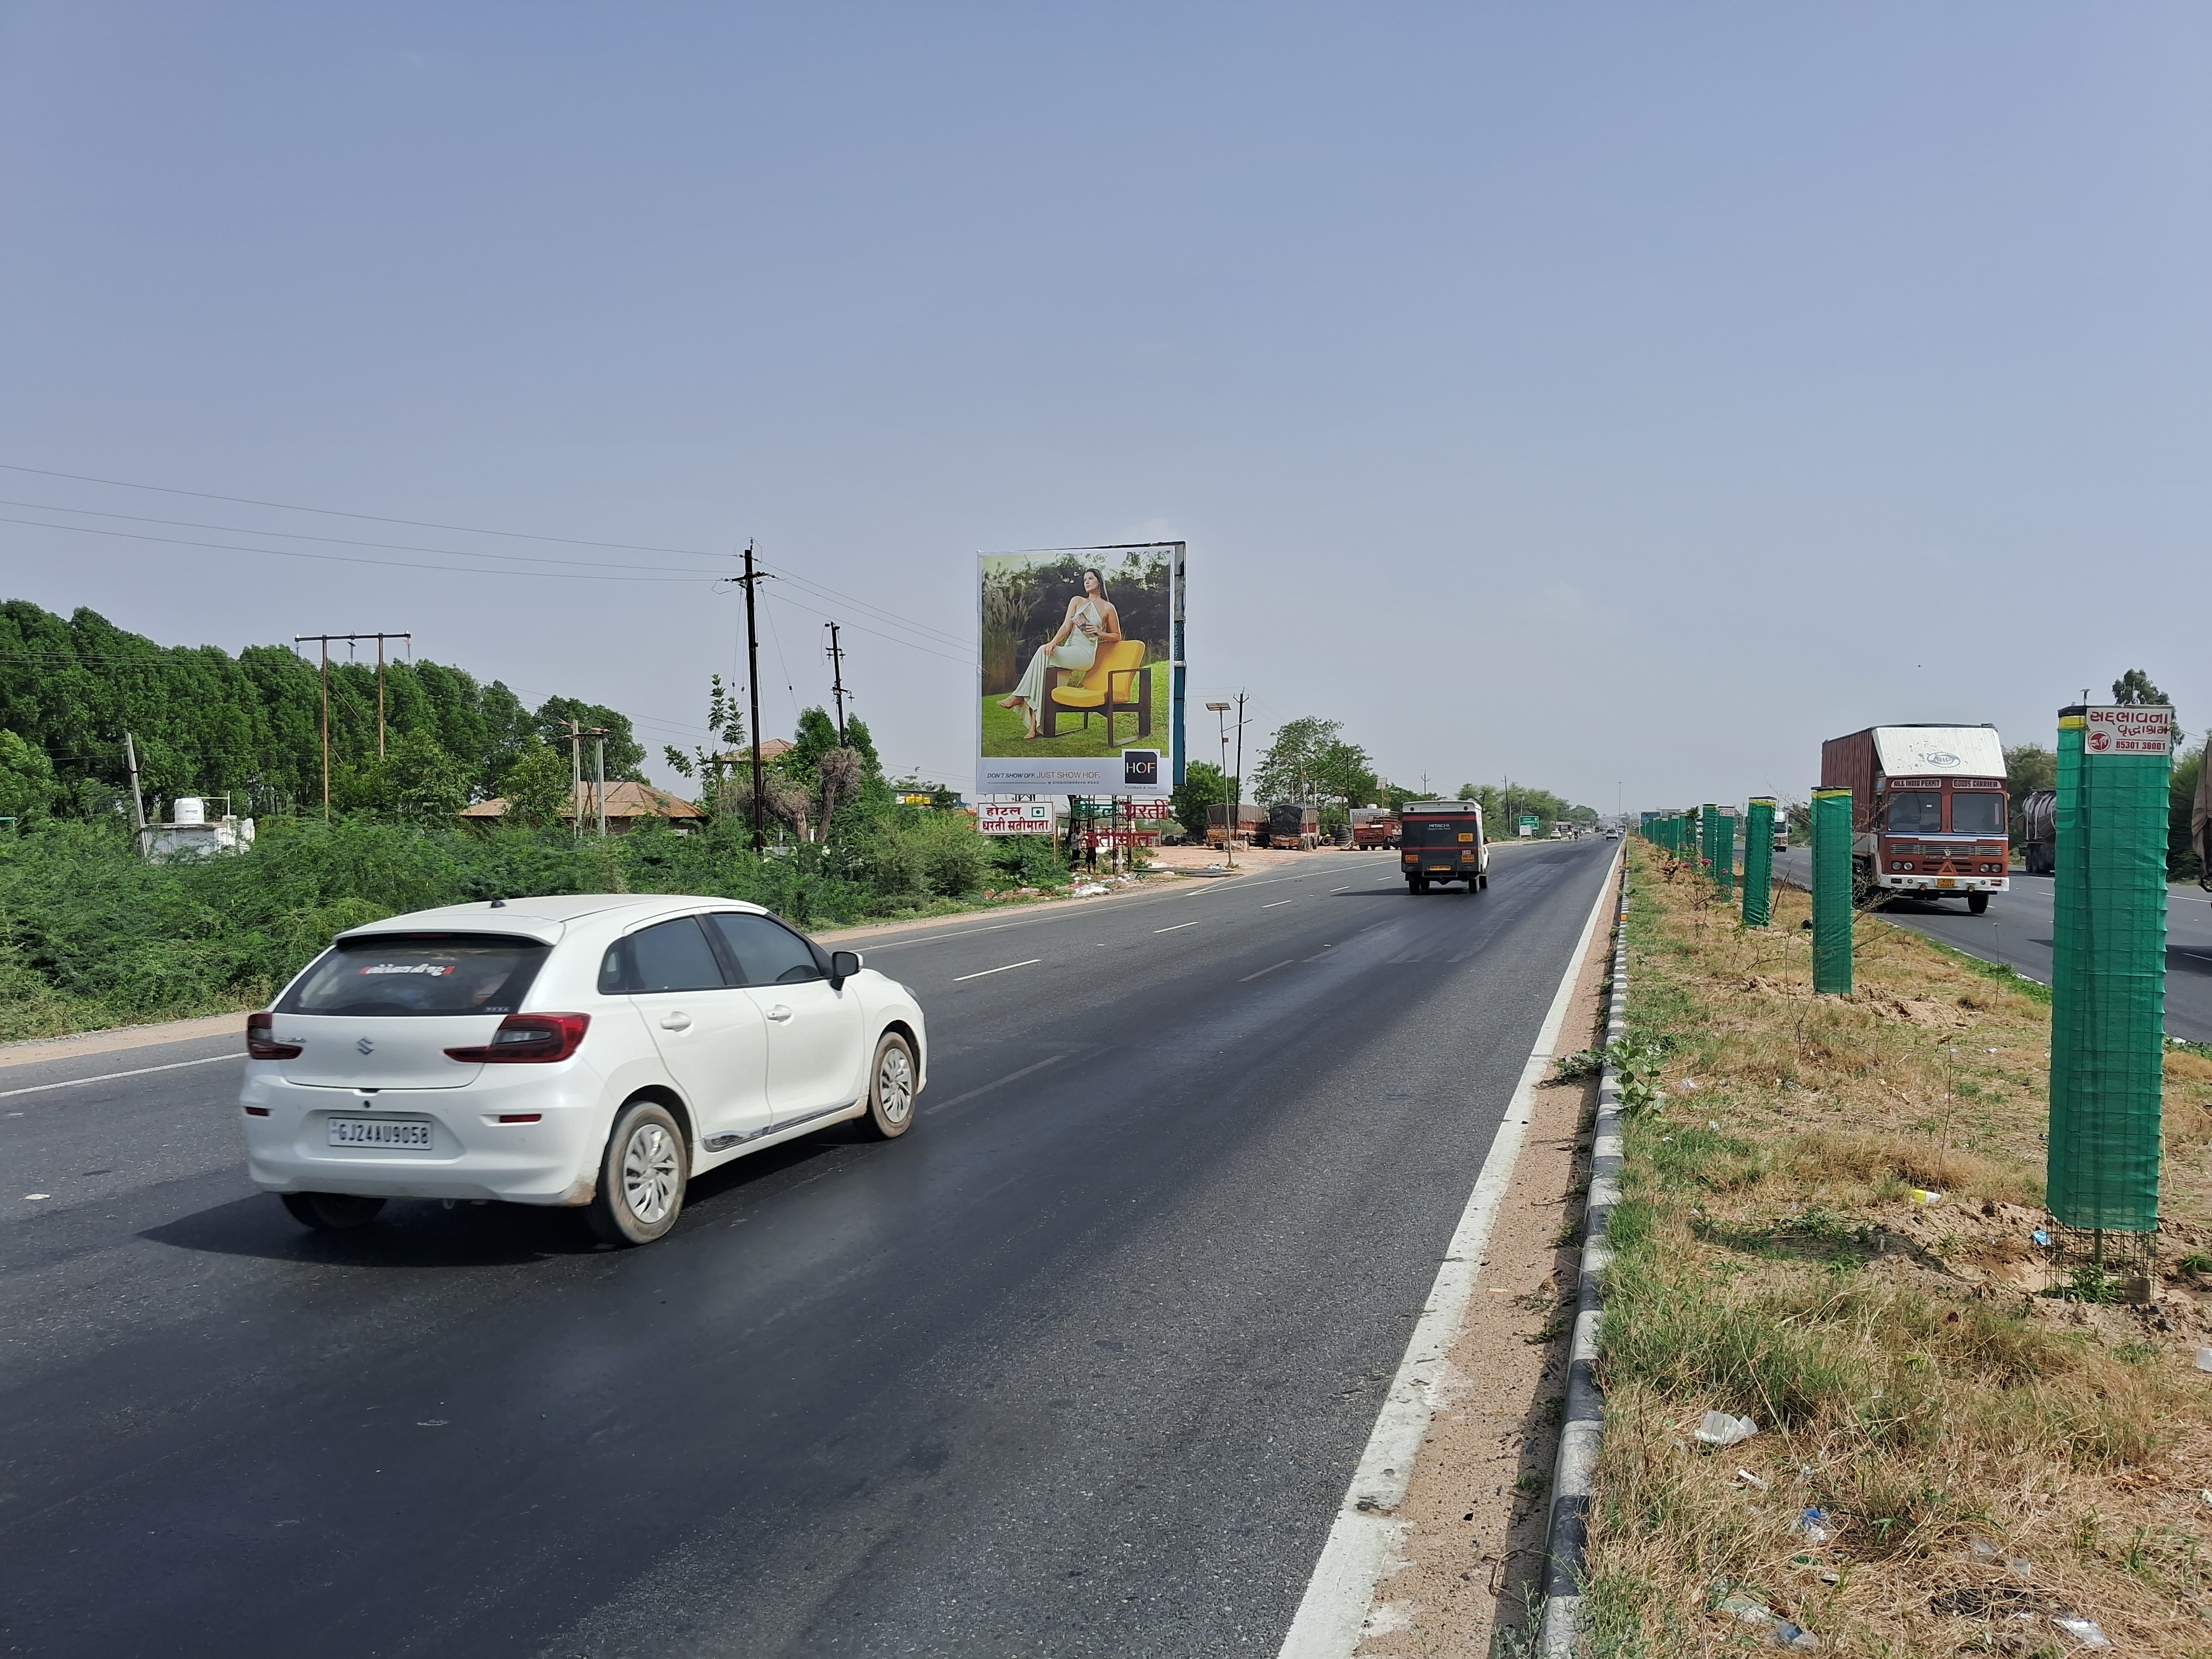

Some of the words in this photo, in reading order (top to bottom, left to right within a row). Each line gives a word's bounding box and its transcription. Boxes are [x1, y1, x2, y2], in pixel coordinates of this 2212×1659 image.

[2116, 741, 2139, 749] 85301
[1126, 762, 1156, 774] HOF
[1953, 779, 1971, 787] GOODS
[1973, 780, 1998, 788] CARRIER
[986, 804, 1022, 816] होटल
[1124, 799, 1168, 820] धरती
[982, 816, 1006, 832] धरती
[1007, 816, 1049, 831] सतीमाता
[339, 1123, 429, 1144] GJ24AU9058
